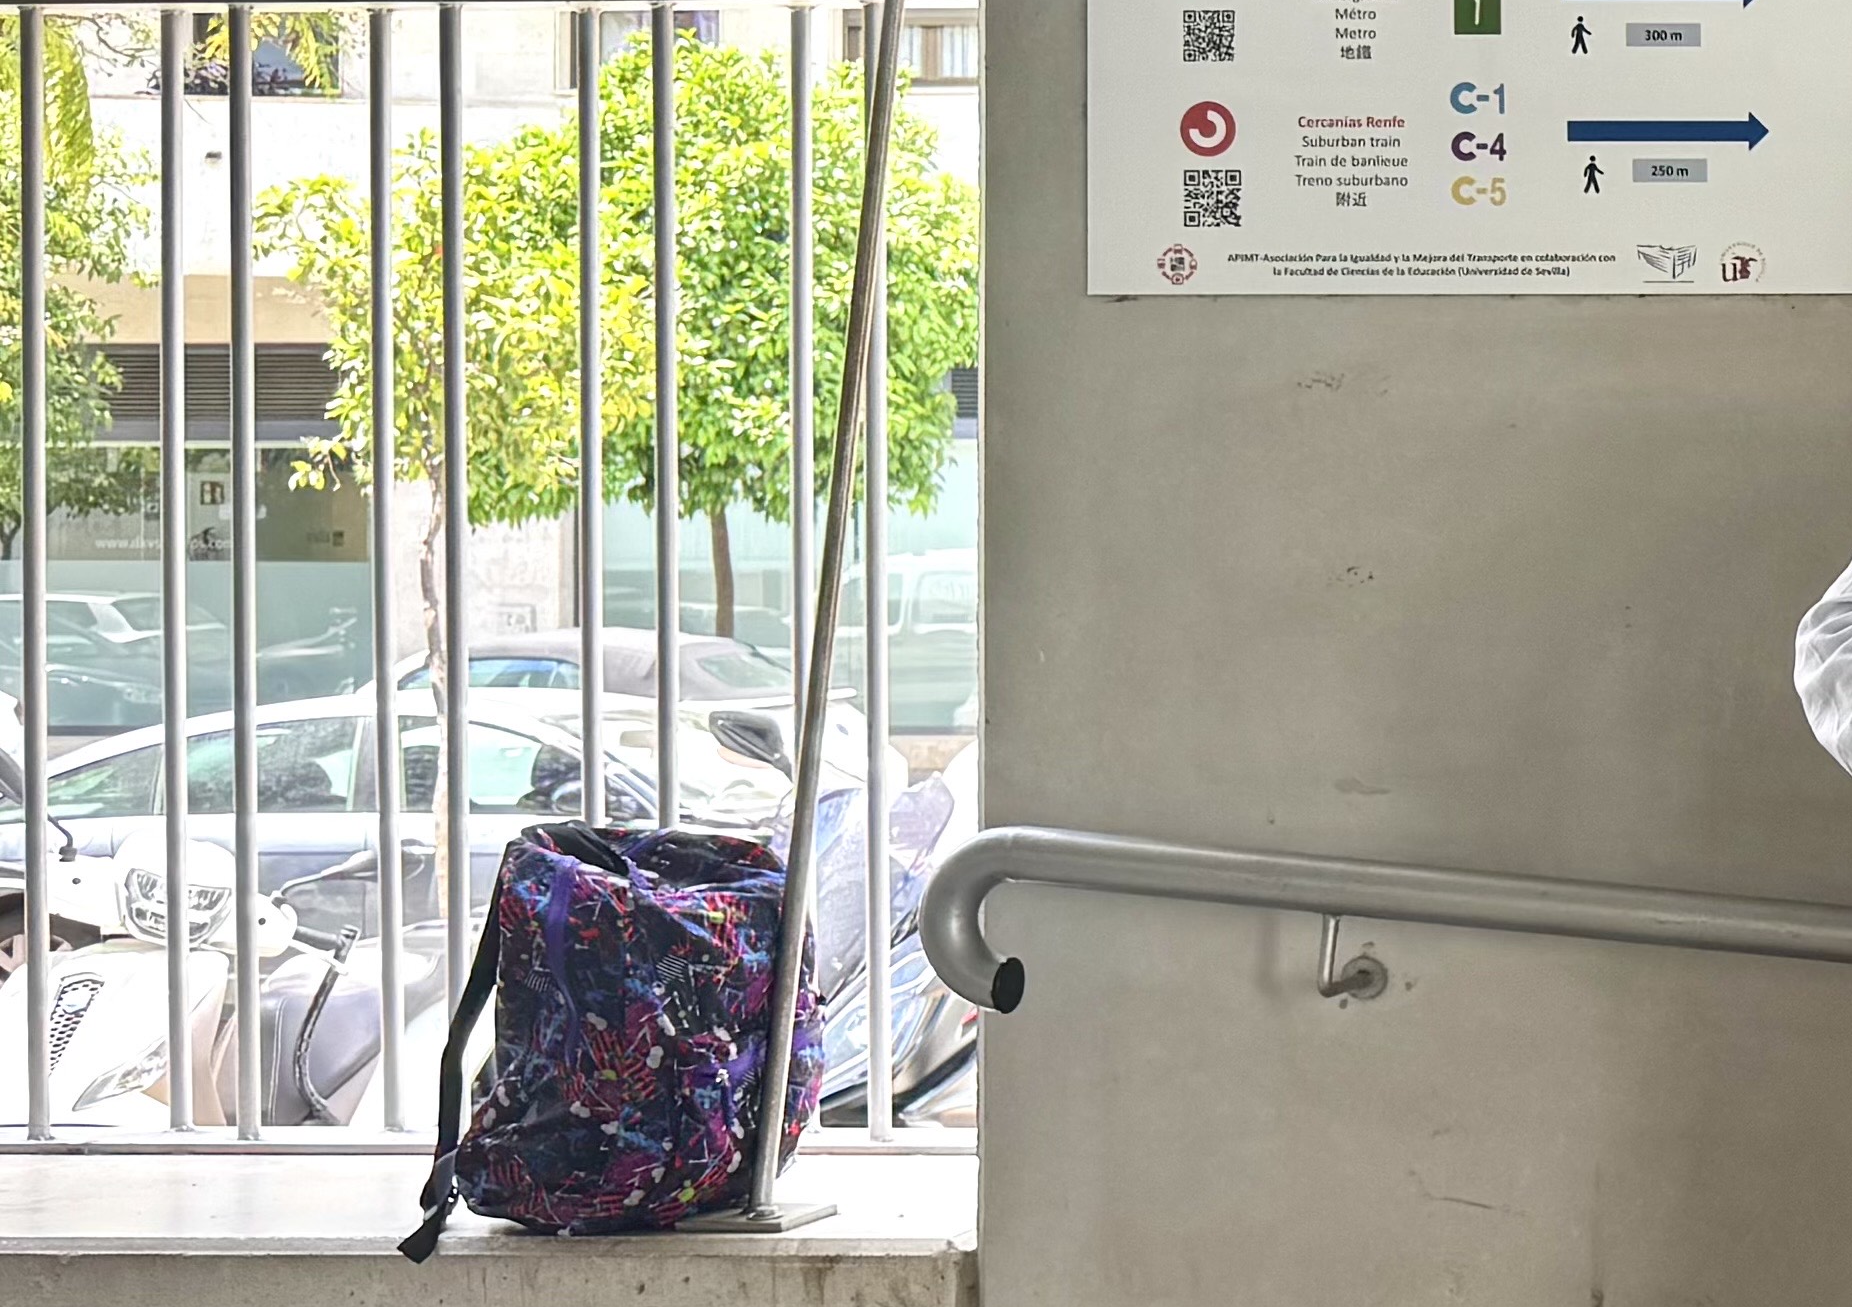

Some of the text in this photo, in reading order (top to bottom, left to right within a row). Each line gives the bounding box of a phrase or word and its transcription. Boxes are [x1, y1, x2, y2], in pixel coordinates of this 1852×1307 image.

[1334, 7, 1377, 20] Métro
[1335, 27, 1377, 40] Metro
[1644, 29, 1683, 42] 300 m
[1449, 81, 1506, 115] C-1
[1297, 115, 1406, 129] Cercanías Renfe
[1301, 135, 1401, 148] Suburban train
[1450, 131, 1507, 162] C-4
[1294, 154, 1409, 168] Train de banlieue
[1651, 165, 1689, 177] 250 m
[1294, 173, 1409, 187] Treno suburbano
[1450, 175, 1507, 207] C-5
